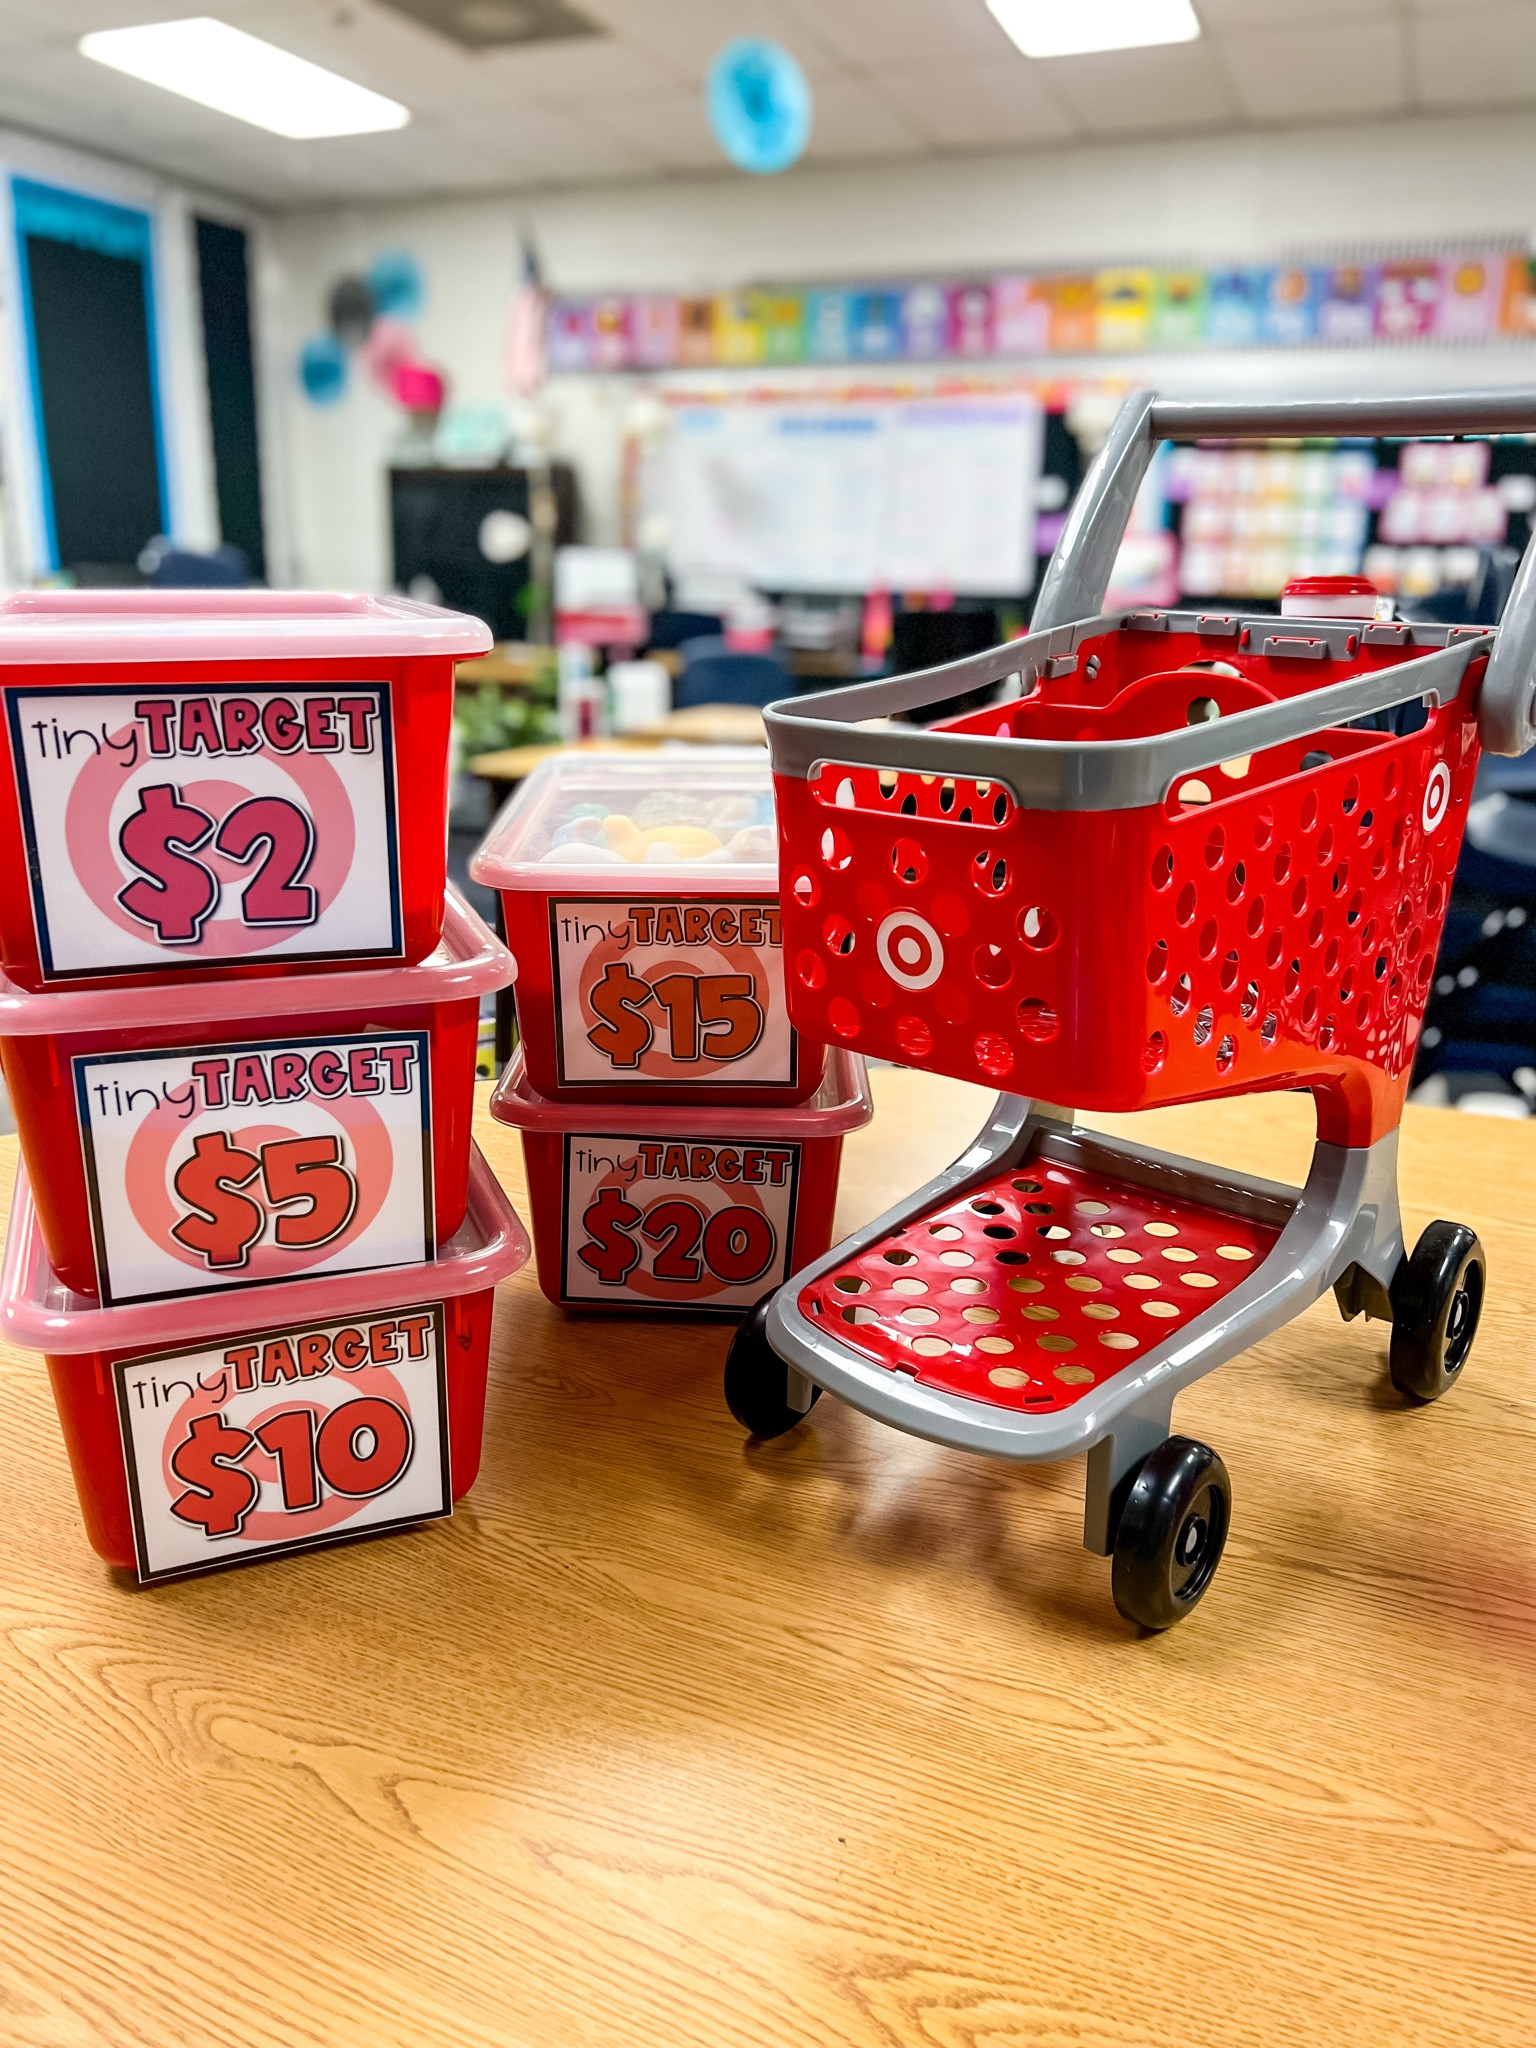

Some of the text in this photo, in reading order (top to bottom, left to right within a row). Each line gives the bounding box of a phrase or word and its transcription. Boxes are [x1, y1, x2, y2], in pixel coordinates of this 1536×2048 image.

[32, 697, 377, 767] tiny TARGET
[116, 784, 317, 943] $2
[561, 907, 783, 949] tiny TARGET
[587, 962, 763, 1068] $15
[94, 1045, 416, 1118] tiny TARGET
[170, 1130, 357, 1268] $5
[576, 1143, 791, 1185] tiny TARGET
[577, 1187, 776, 1284] $20
[132, 1316, 433, 1409] tiny TARGET
[170, 1397, 413, 1539] $10
